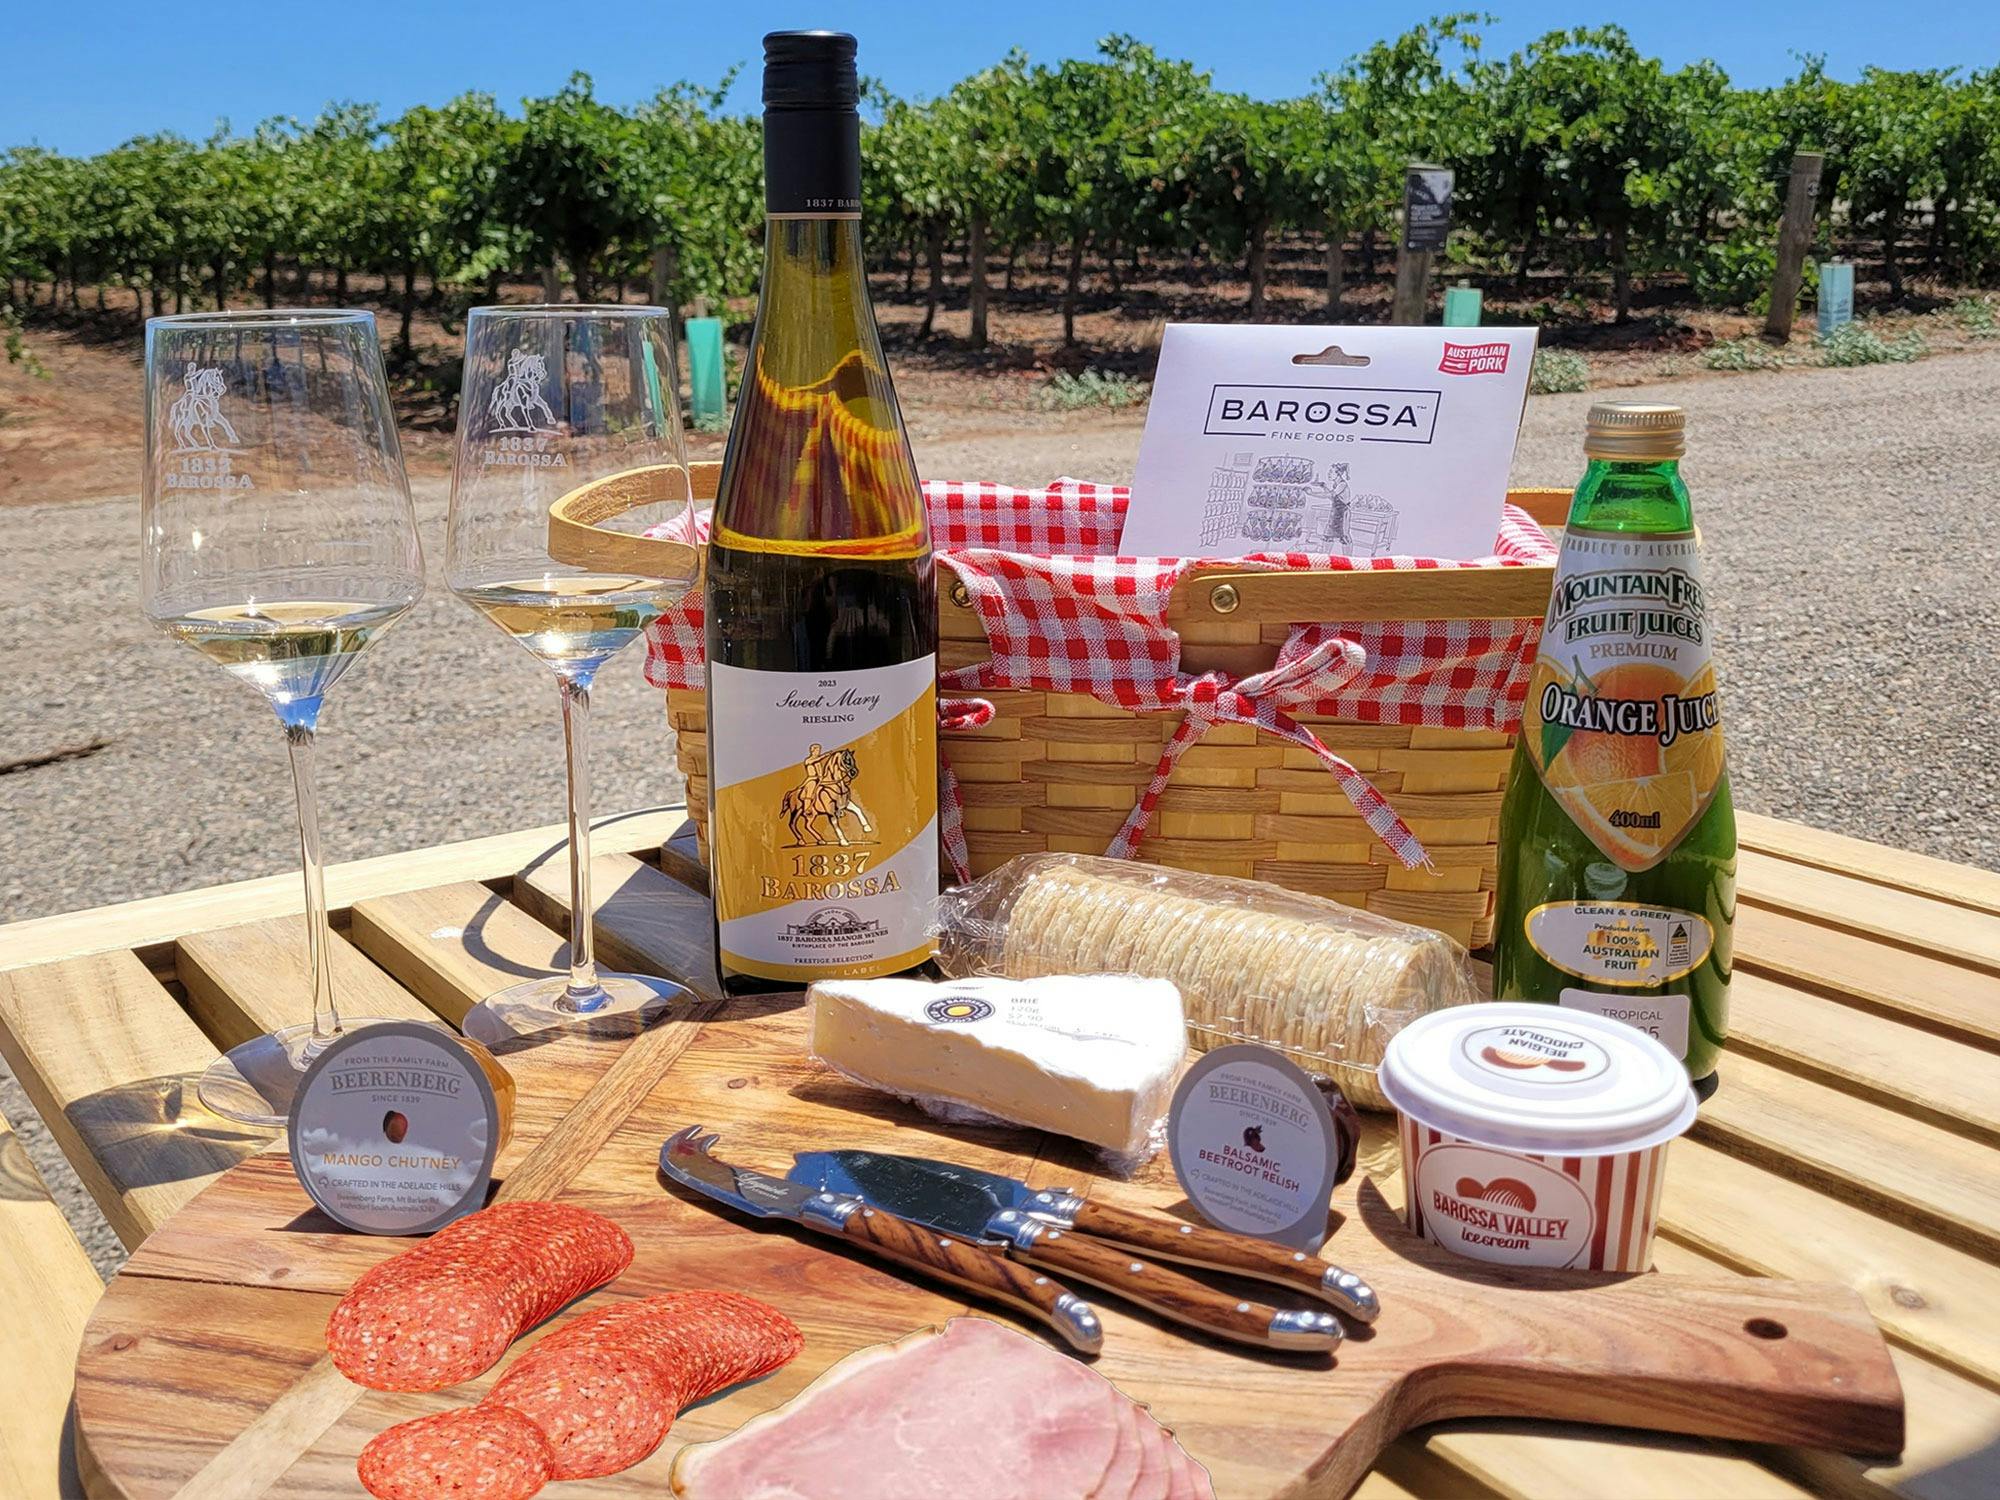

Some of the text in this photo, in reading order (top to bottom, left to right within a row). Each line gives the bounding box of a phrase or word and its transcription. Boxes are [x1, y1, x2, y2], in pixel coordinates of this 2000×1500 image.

[806, 199, 834, 208] 1837
[1447, 346, 1507, 359] AUSTRALIAN
[1468, 357, 1505, 372] PORK
[1221, 399, 1418, 428] BAROSSA
[500, 436, 549, 453] 1837
[1271, 431, 1355, 443] FINE FOODS
[484, 450, 569, 467] BAROSSA
[1565, 537, 1617, 555] PRODUCT
[1623, 544, 1641, 556] OF
[1567, 611, 1703, 643] FRUIT JUICES
[1590, 643, 1678, 661] PREMIUM
[818, 679, 837, 688] 2023
[776, 688, 880, 711] Sweet Mary
[802, 714, 855, 724] RIESLING
[1542, 683, 1719, 745] ORANGE JUICE
[1609, 810, 1661, 828] 400ml
[792, 852, 872, 878] 1837
[761, 870, 901, 900] BAROSSA
[1574, 907, 1614, 915] CLEAN
[1630, 909, 1671, 920] GREEN
[833, 934, 863, 942] MANOR
[865, 929, 889, 938] WINES
[1594, 923, 1630, 932] Produced
[1606, 935, 1640, 945] 100%
[832, 954, 874, 963] SELECTION
[1582, 945, 1660, 958] AUSTRALIAN
[1604, 959, 1638, 970] FRUIT
[1601, 1008, 1664, 1020] TROPICAL
[1500, 1028, 1584, 1049] CHOCOLATE
[1508, 1038, 1568, 1058] BELGIAN
[344, 1056, 369, 1066] FROM
[392, 1056, 424, 1065] FAMILY
[425, 1059, 449, 1068] FARM
[331, 1070, 461, 1094] BEERENBERG
[1208, 1084, 1310, 1128] BEERENBERG
[323, 1153, 461, 1170] MANGO CHUTNEY
[1223, 1144, 1281, 1172] BALSAMIC
[1199, 1149, 1300, 1193] BEETROOT RELISH
[331, 1179, 369, 1188] CRAFTED
[370, 1180, 379, 1188] IN
[381, 1181, 397, 1189] THE
[398, 1181, 438, 1191] ADELAIDE
[1433, 1190, 1569, 1239] BAROSSA VALLEY
